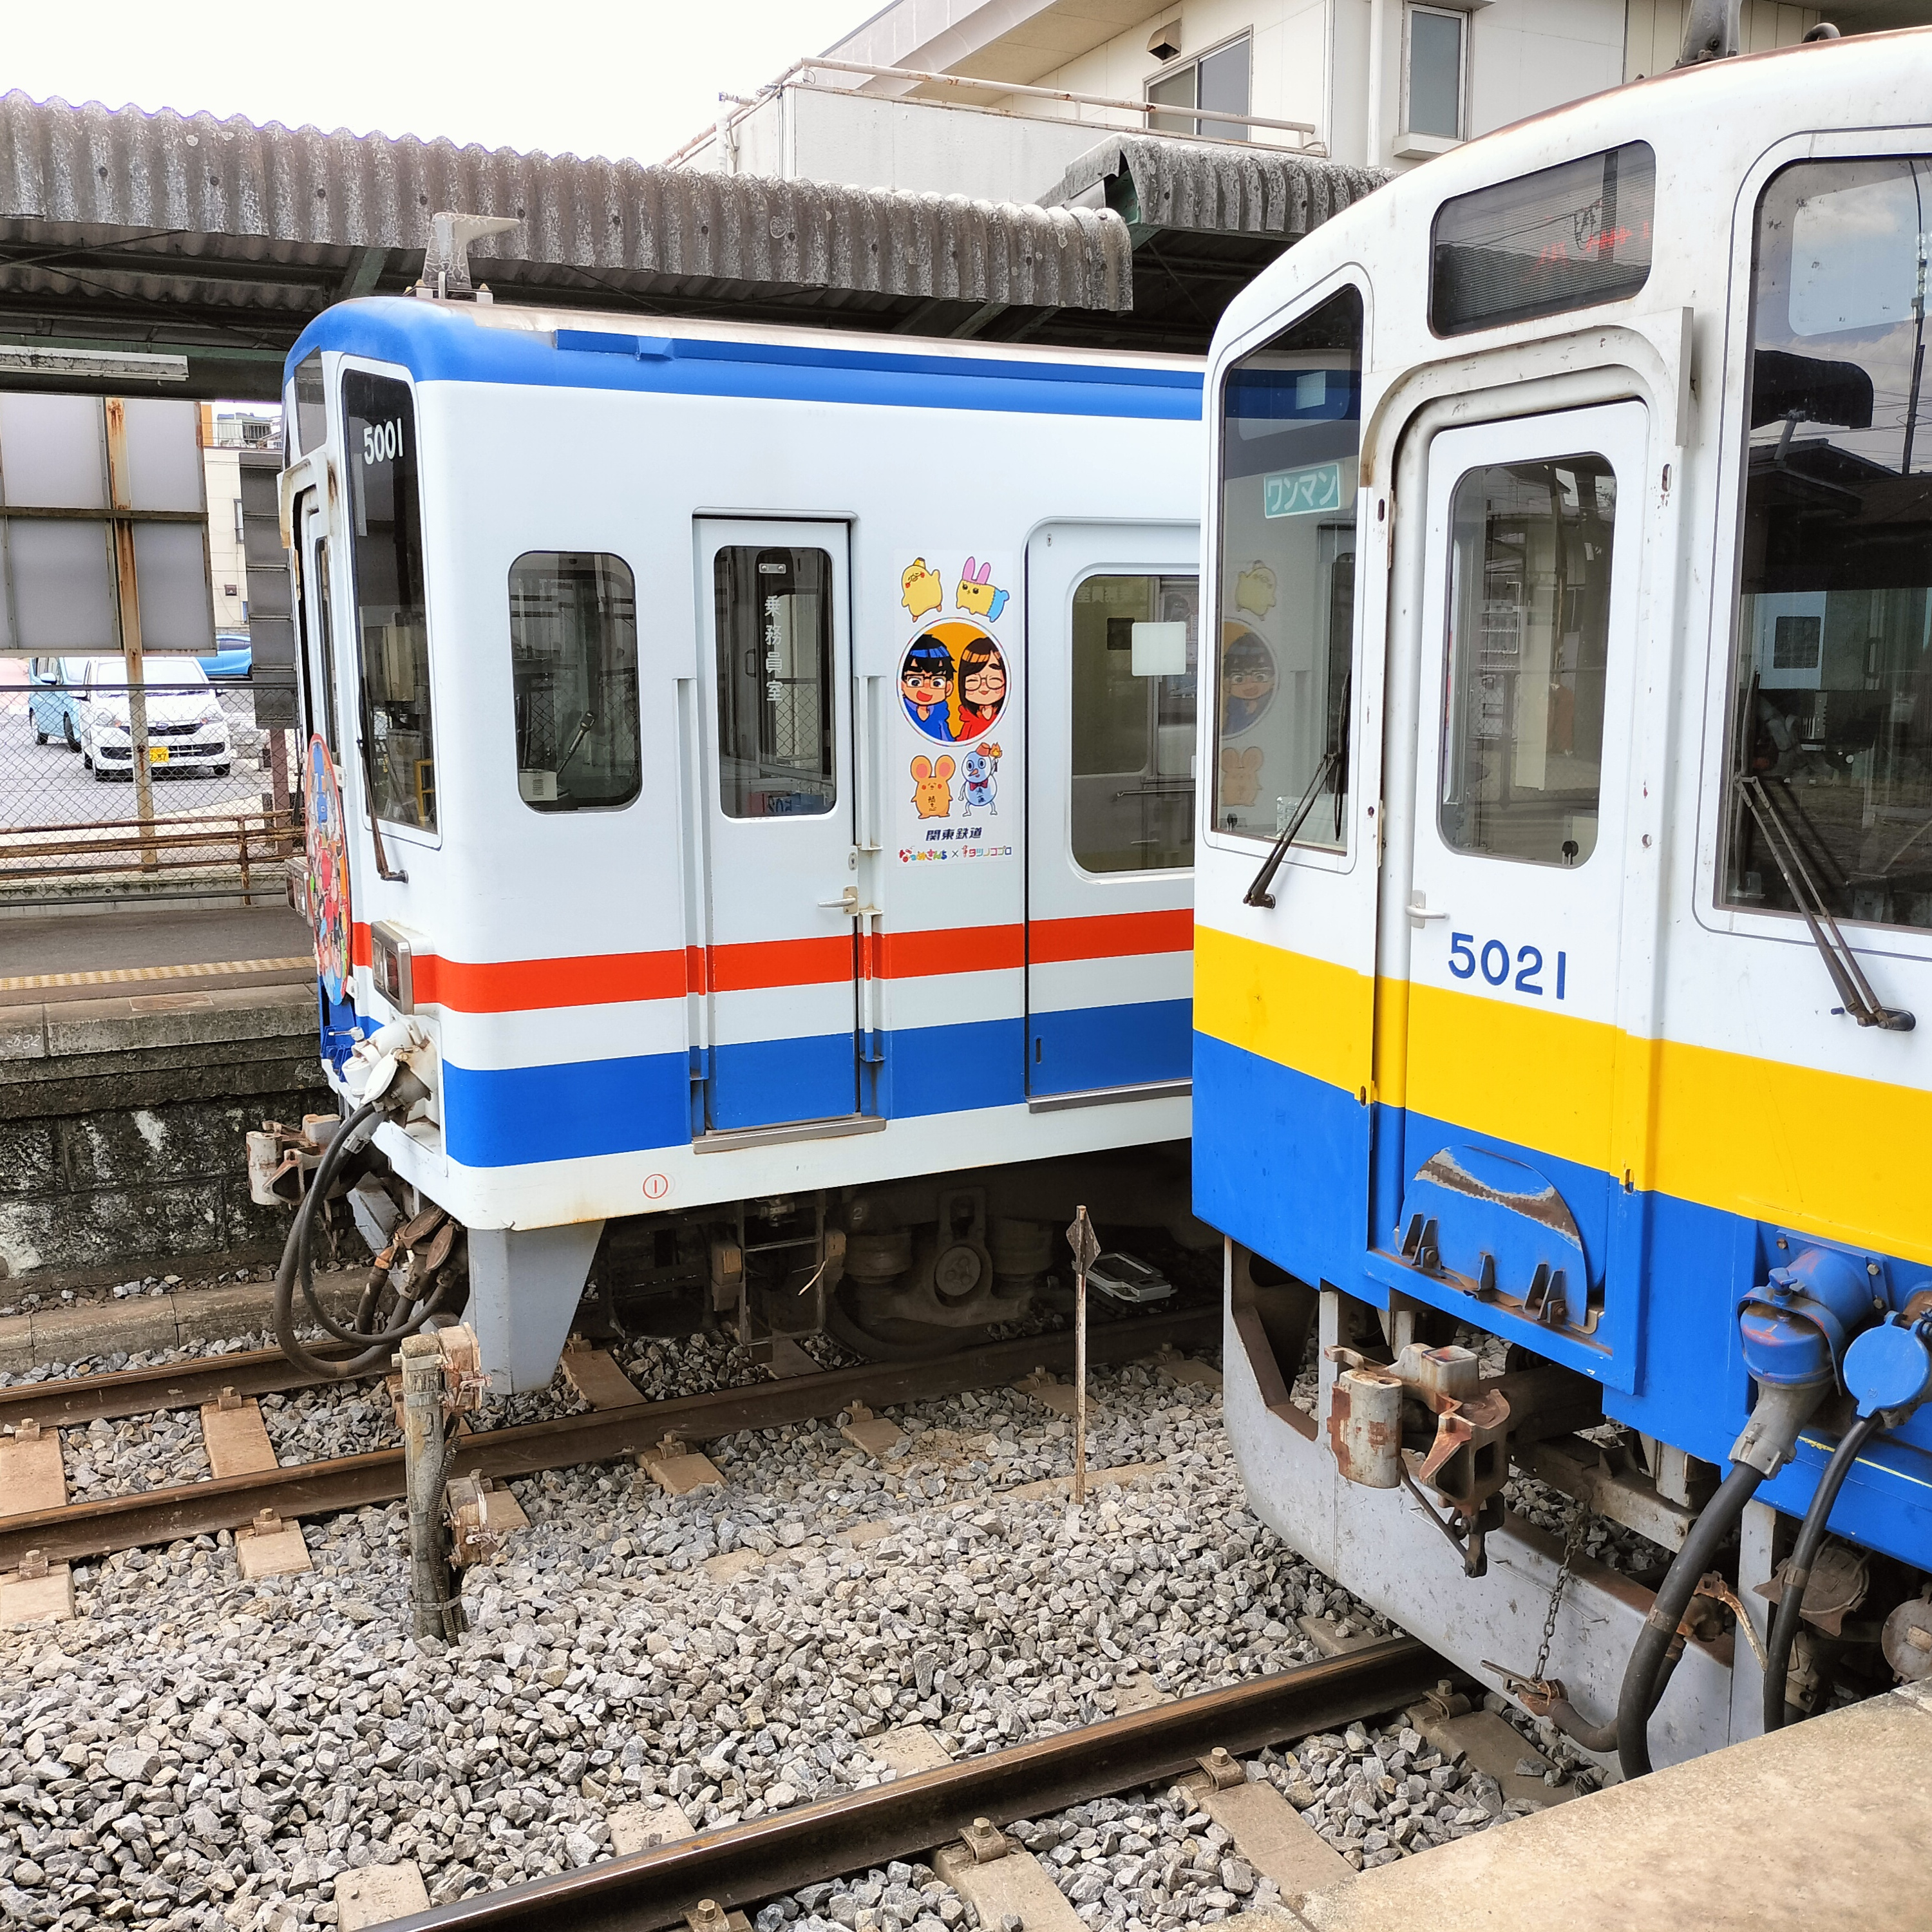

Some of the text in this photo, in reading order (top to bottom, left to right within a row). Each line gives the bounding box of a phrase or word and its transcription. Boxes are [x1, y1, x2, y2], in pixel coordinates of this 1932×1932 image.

[363, 417, 403, 465] 5001
[1267, 471, 1336, 512] ワンマン
[764, 594, 783, 703] 乗務員室
[925, 827, 982, 841] 関東鉄道
[969, 845, 1012, 858] タツノコプロ
[1448, 931, 1566, 1000] 5021
